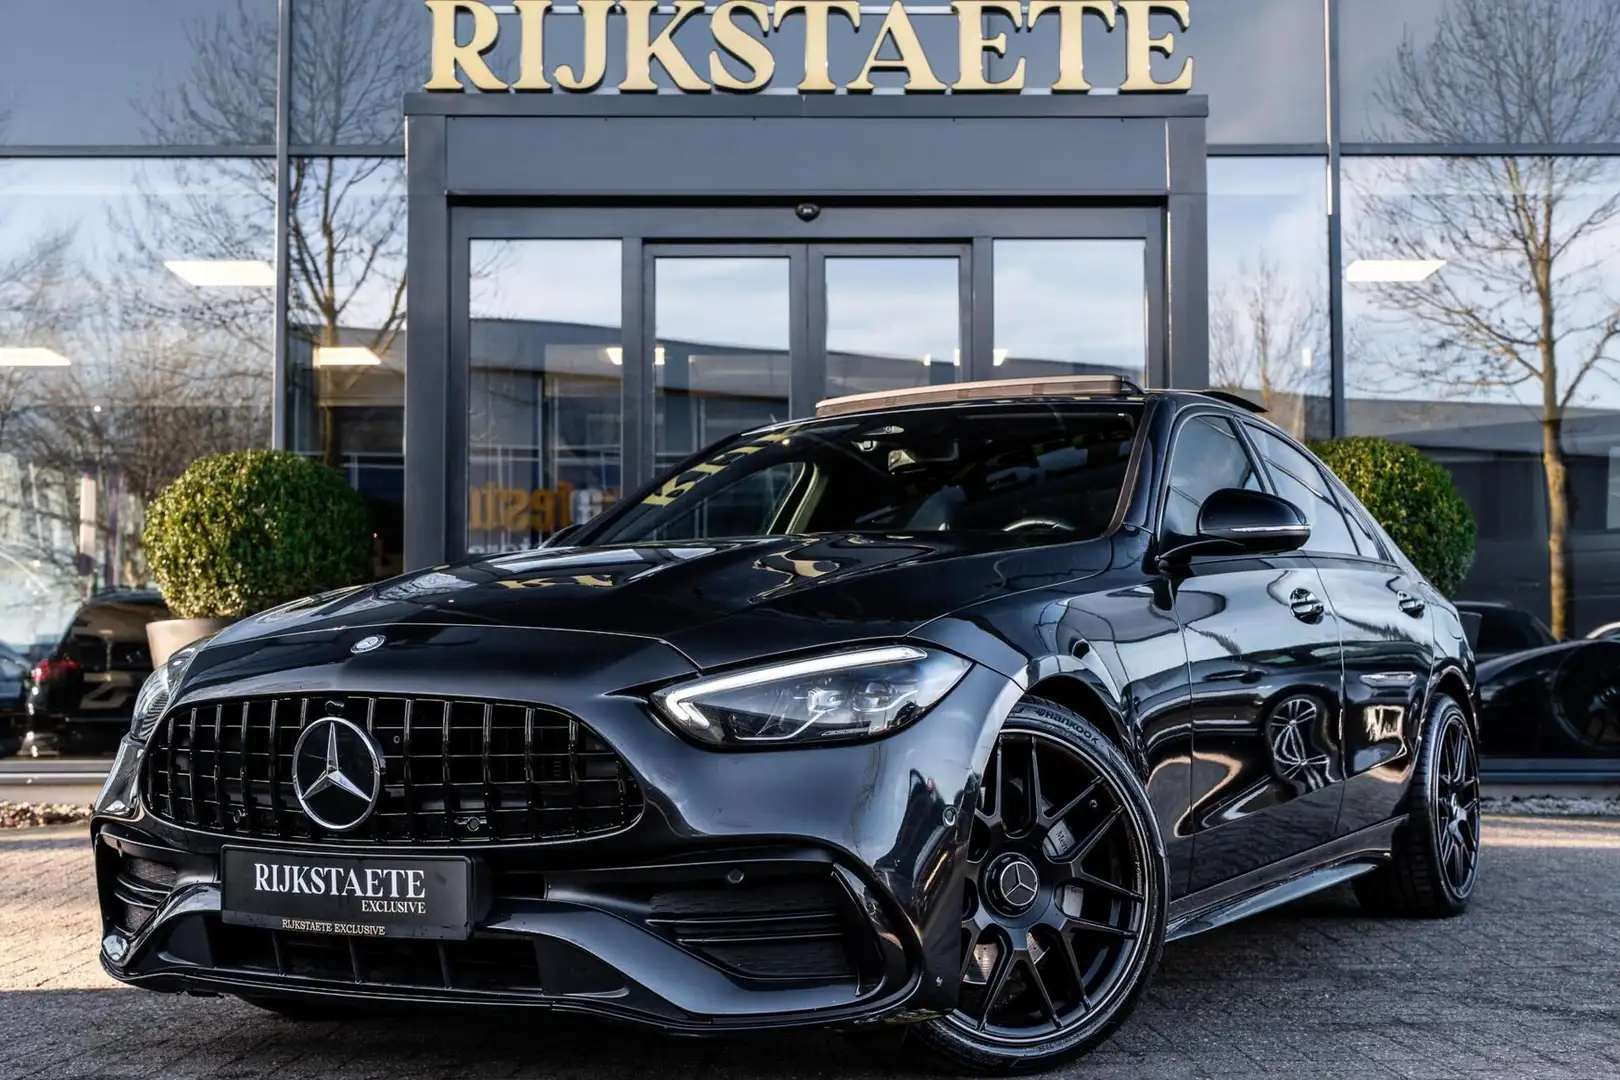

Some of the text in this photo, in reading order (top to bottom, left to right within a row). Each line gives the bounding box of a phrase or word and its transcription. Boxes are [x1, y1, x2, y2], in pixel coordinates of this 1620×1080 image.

[423, 0, 1193, 93] RIJKSTAETE
[254, 863, 426, 898] RIJKSTAETE
[361, 899, 426, 914] EXCLUSIVE
[282, 919, 386, 936] RIJKSTAETE EXCLUSIVE
